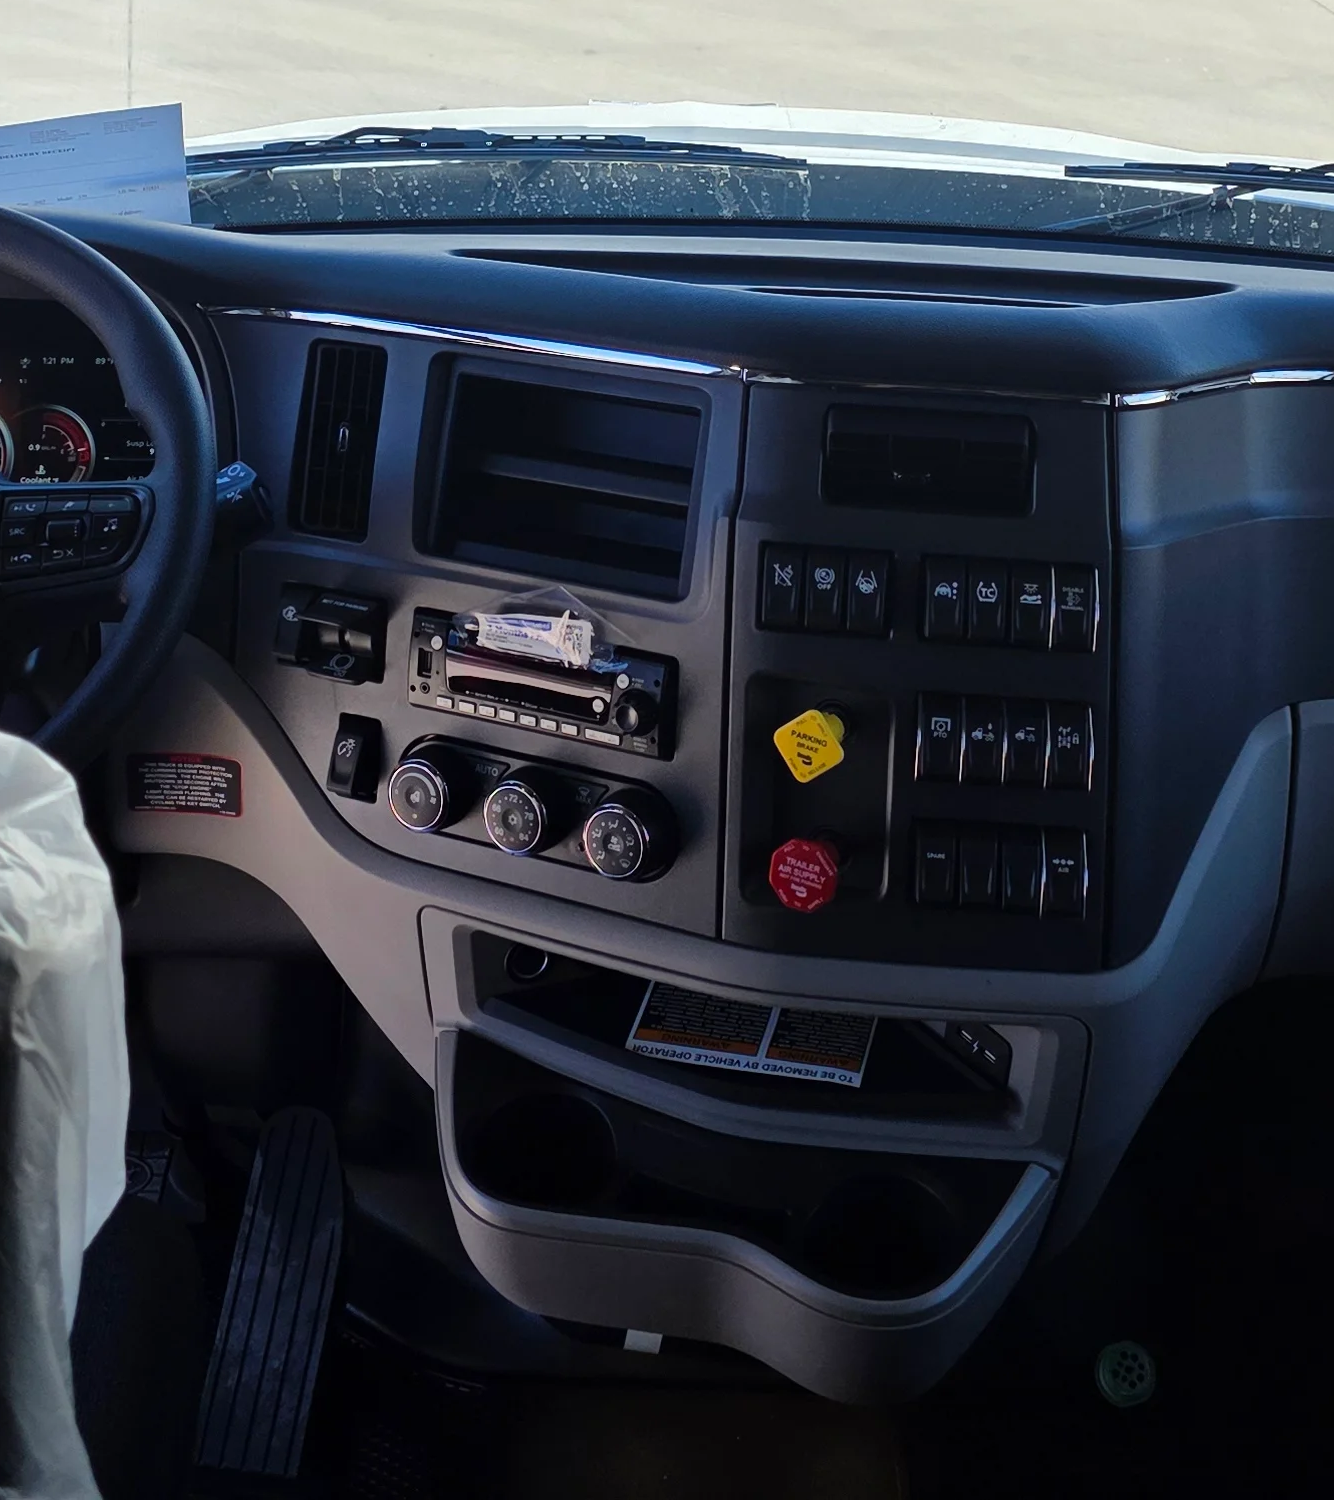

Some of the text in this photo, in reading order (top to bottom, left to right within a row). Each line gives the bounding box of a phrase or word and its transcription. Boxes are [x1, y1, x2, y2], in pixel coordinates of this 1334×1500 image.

[95, 357, 106, 365] 89
[8, 528, 25, 536] SRC
[791, 730, 827, 747] PARKING
[797, 742, 819, 753] BRAKE
[475, 764, 499, 777] AUTO
[509, 794, 518, 803] 72
[927, 852, 945, 860] SPARE
[786, 856, 820, 873] TRAILER
[778, 864, 826, 884] AIR SUPPLY
[660, 1033, 719, 1050] WARNING
[631, 1043, 854, 1084] TO BE REMOVED BY VEHICLE OPERATOR
[779, 1050, 839, 1066] WARNING
